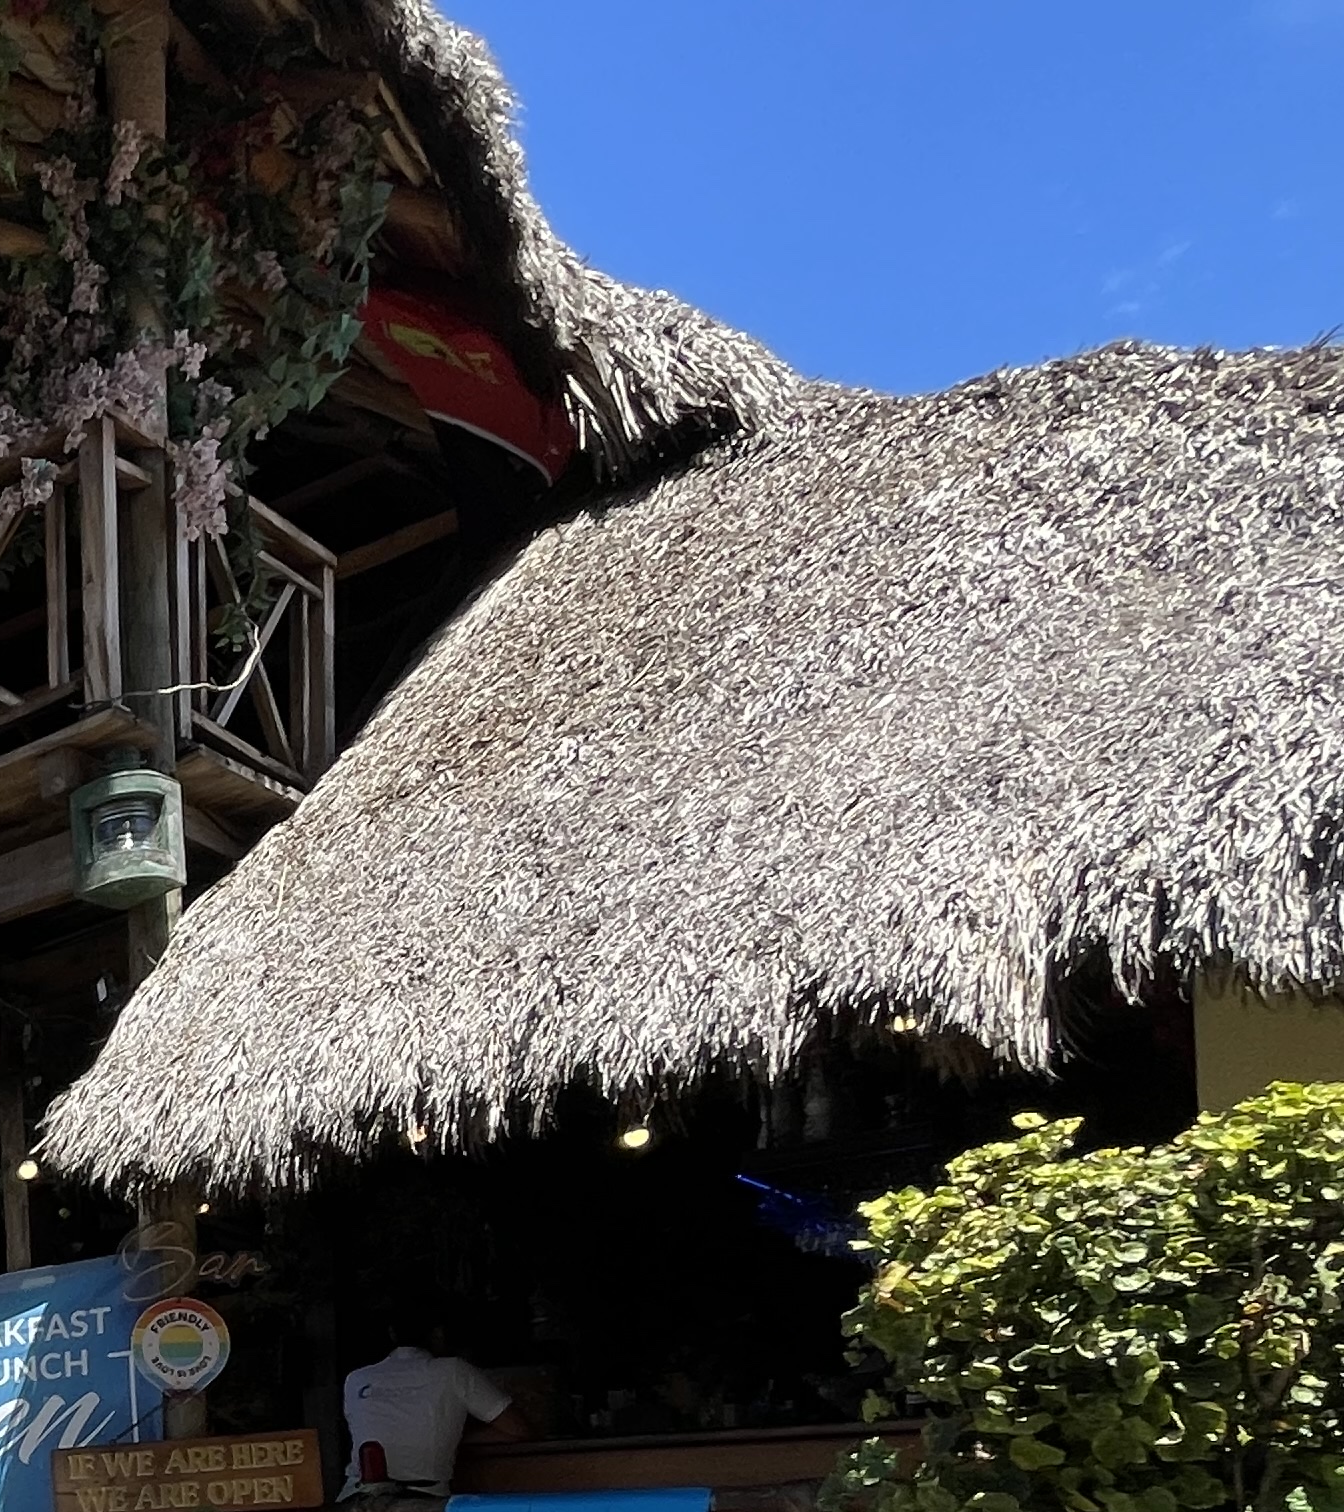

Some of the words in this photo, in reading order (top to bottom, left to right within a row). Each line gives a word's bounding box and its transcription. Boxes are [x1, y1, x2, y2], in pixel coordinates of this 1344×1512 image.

[151, 1312, 210, 1333] FRIENDLY
[151, 1357, 174, 1375] LOVE
[67, 1454, 95, 1479] IF
[102, 1451, 155, 1477] WE
[164, 1445, 227, 1474] ARE
[231, 1439, 305, 1470] HERE
[134, 1481, 201, 1510] ARE
[207, 1474, 294, 1504] OPEN
